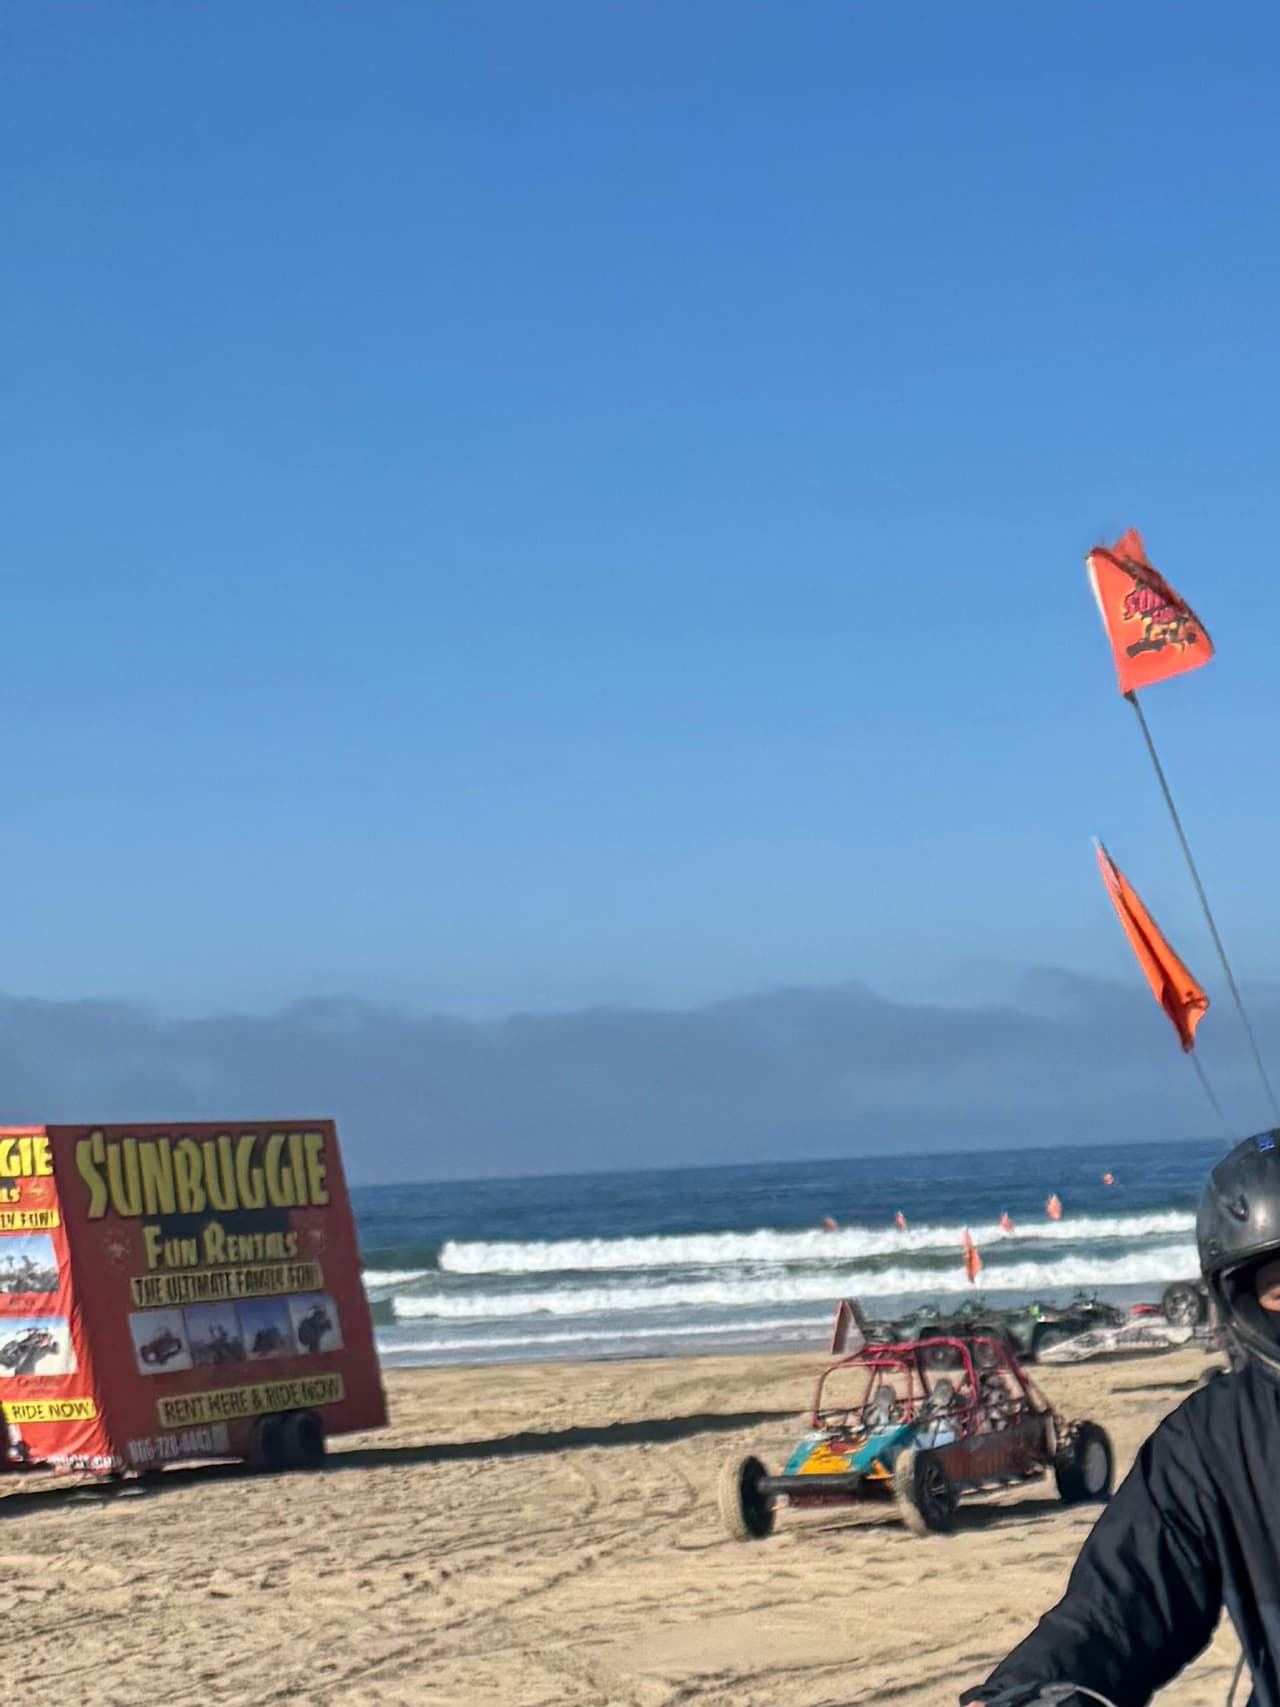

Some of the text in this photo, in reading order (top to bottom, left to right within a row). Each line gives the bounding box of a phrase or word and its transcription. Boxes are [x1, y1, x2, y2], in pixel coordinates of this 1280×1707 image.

[75, 1130, 329, 1219] SUNBUGGIE
[12, 1401, 90, 1419] RIDE NOW
